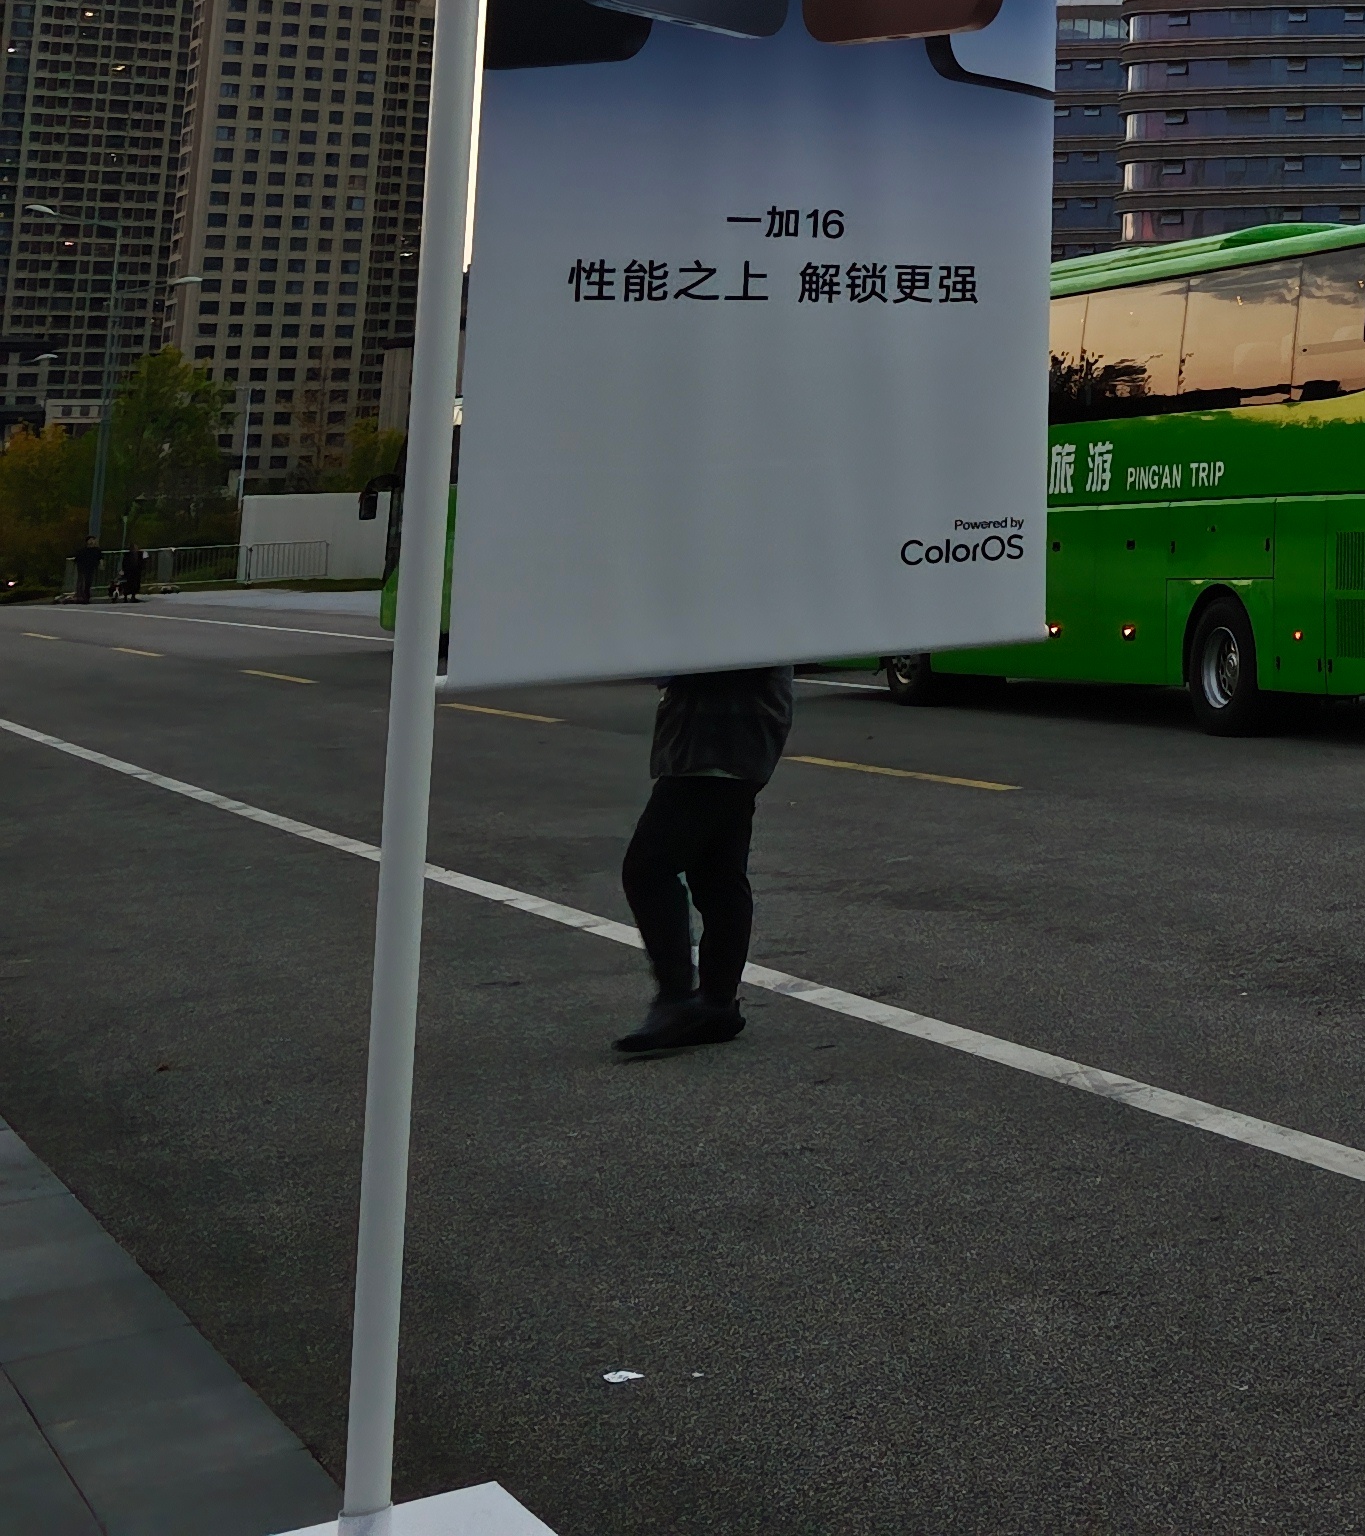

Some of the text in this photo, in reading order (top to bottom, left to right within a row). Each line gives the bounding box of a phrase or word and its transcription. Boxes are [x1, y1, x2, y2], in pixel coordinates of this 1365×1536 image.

[727, 206, 845, 239] 一加16
[568, 259, 979, 304] 性能之上 解锁更强
[1126, 463, 1182, 492] PING'AN
[1189, 461, 1225, 488] TRIP
[954, 516, 1024, 531] Powered by
[900, 533, 1024, 566] ColorOS
